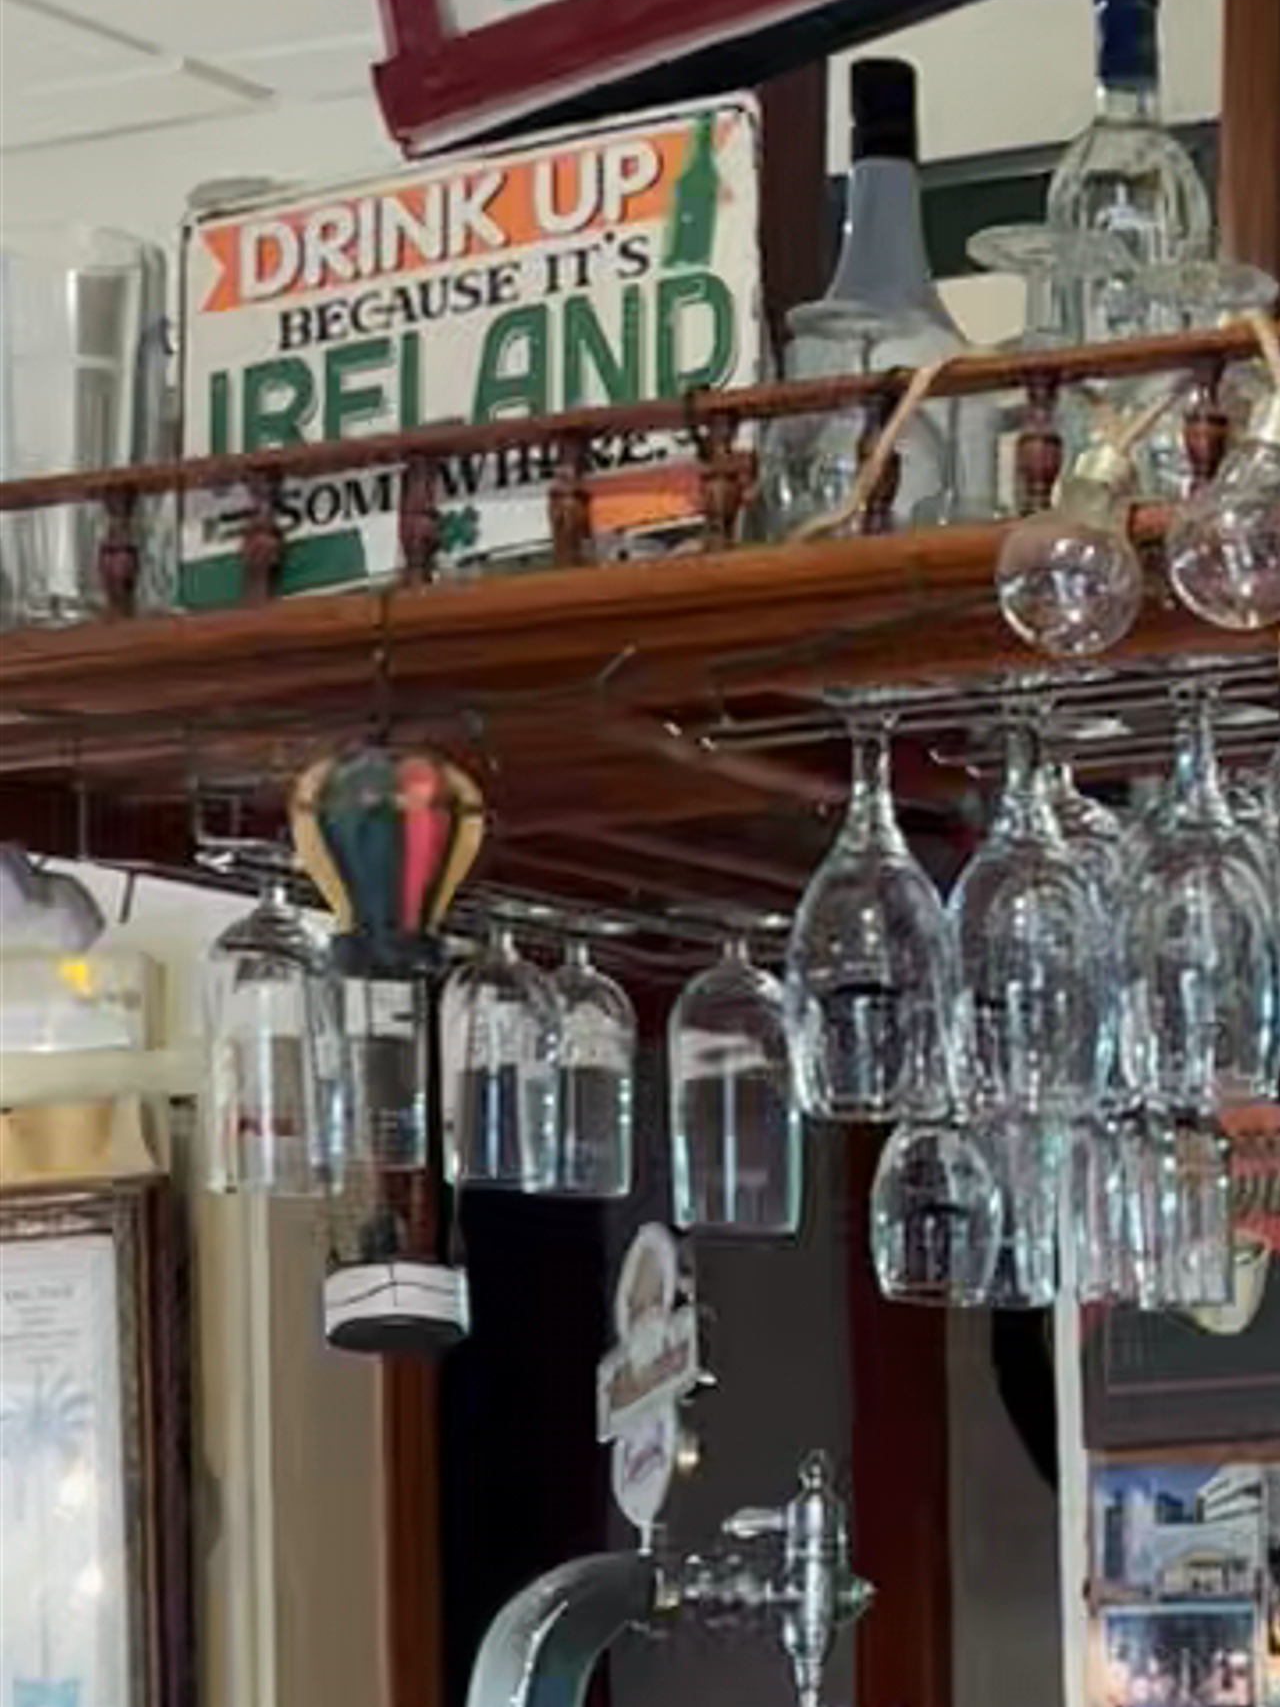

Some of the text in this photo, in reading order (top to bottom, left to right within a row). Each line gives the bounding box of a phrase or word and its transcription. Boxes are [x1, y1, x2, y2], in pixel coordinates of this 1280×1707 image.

[239, 140, 662, 302] DRINK UP
[278, 231, 652, 352] BECAUSE IT'S
[209, 272, 739, 456] IRELAND
